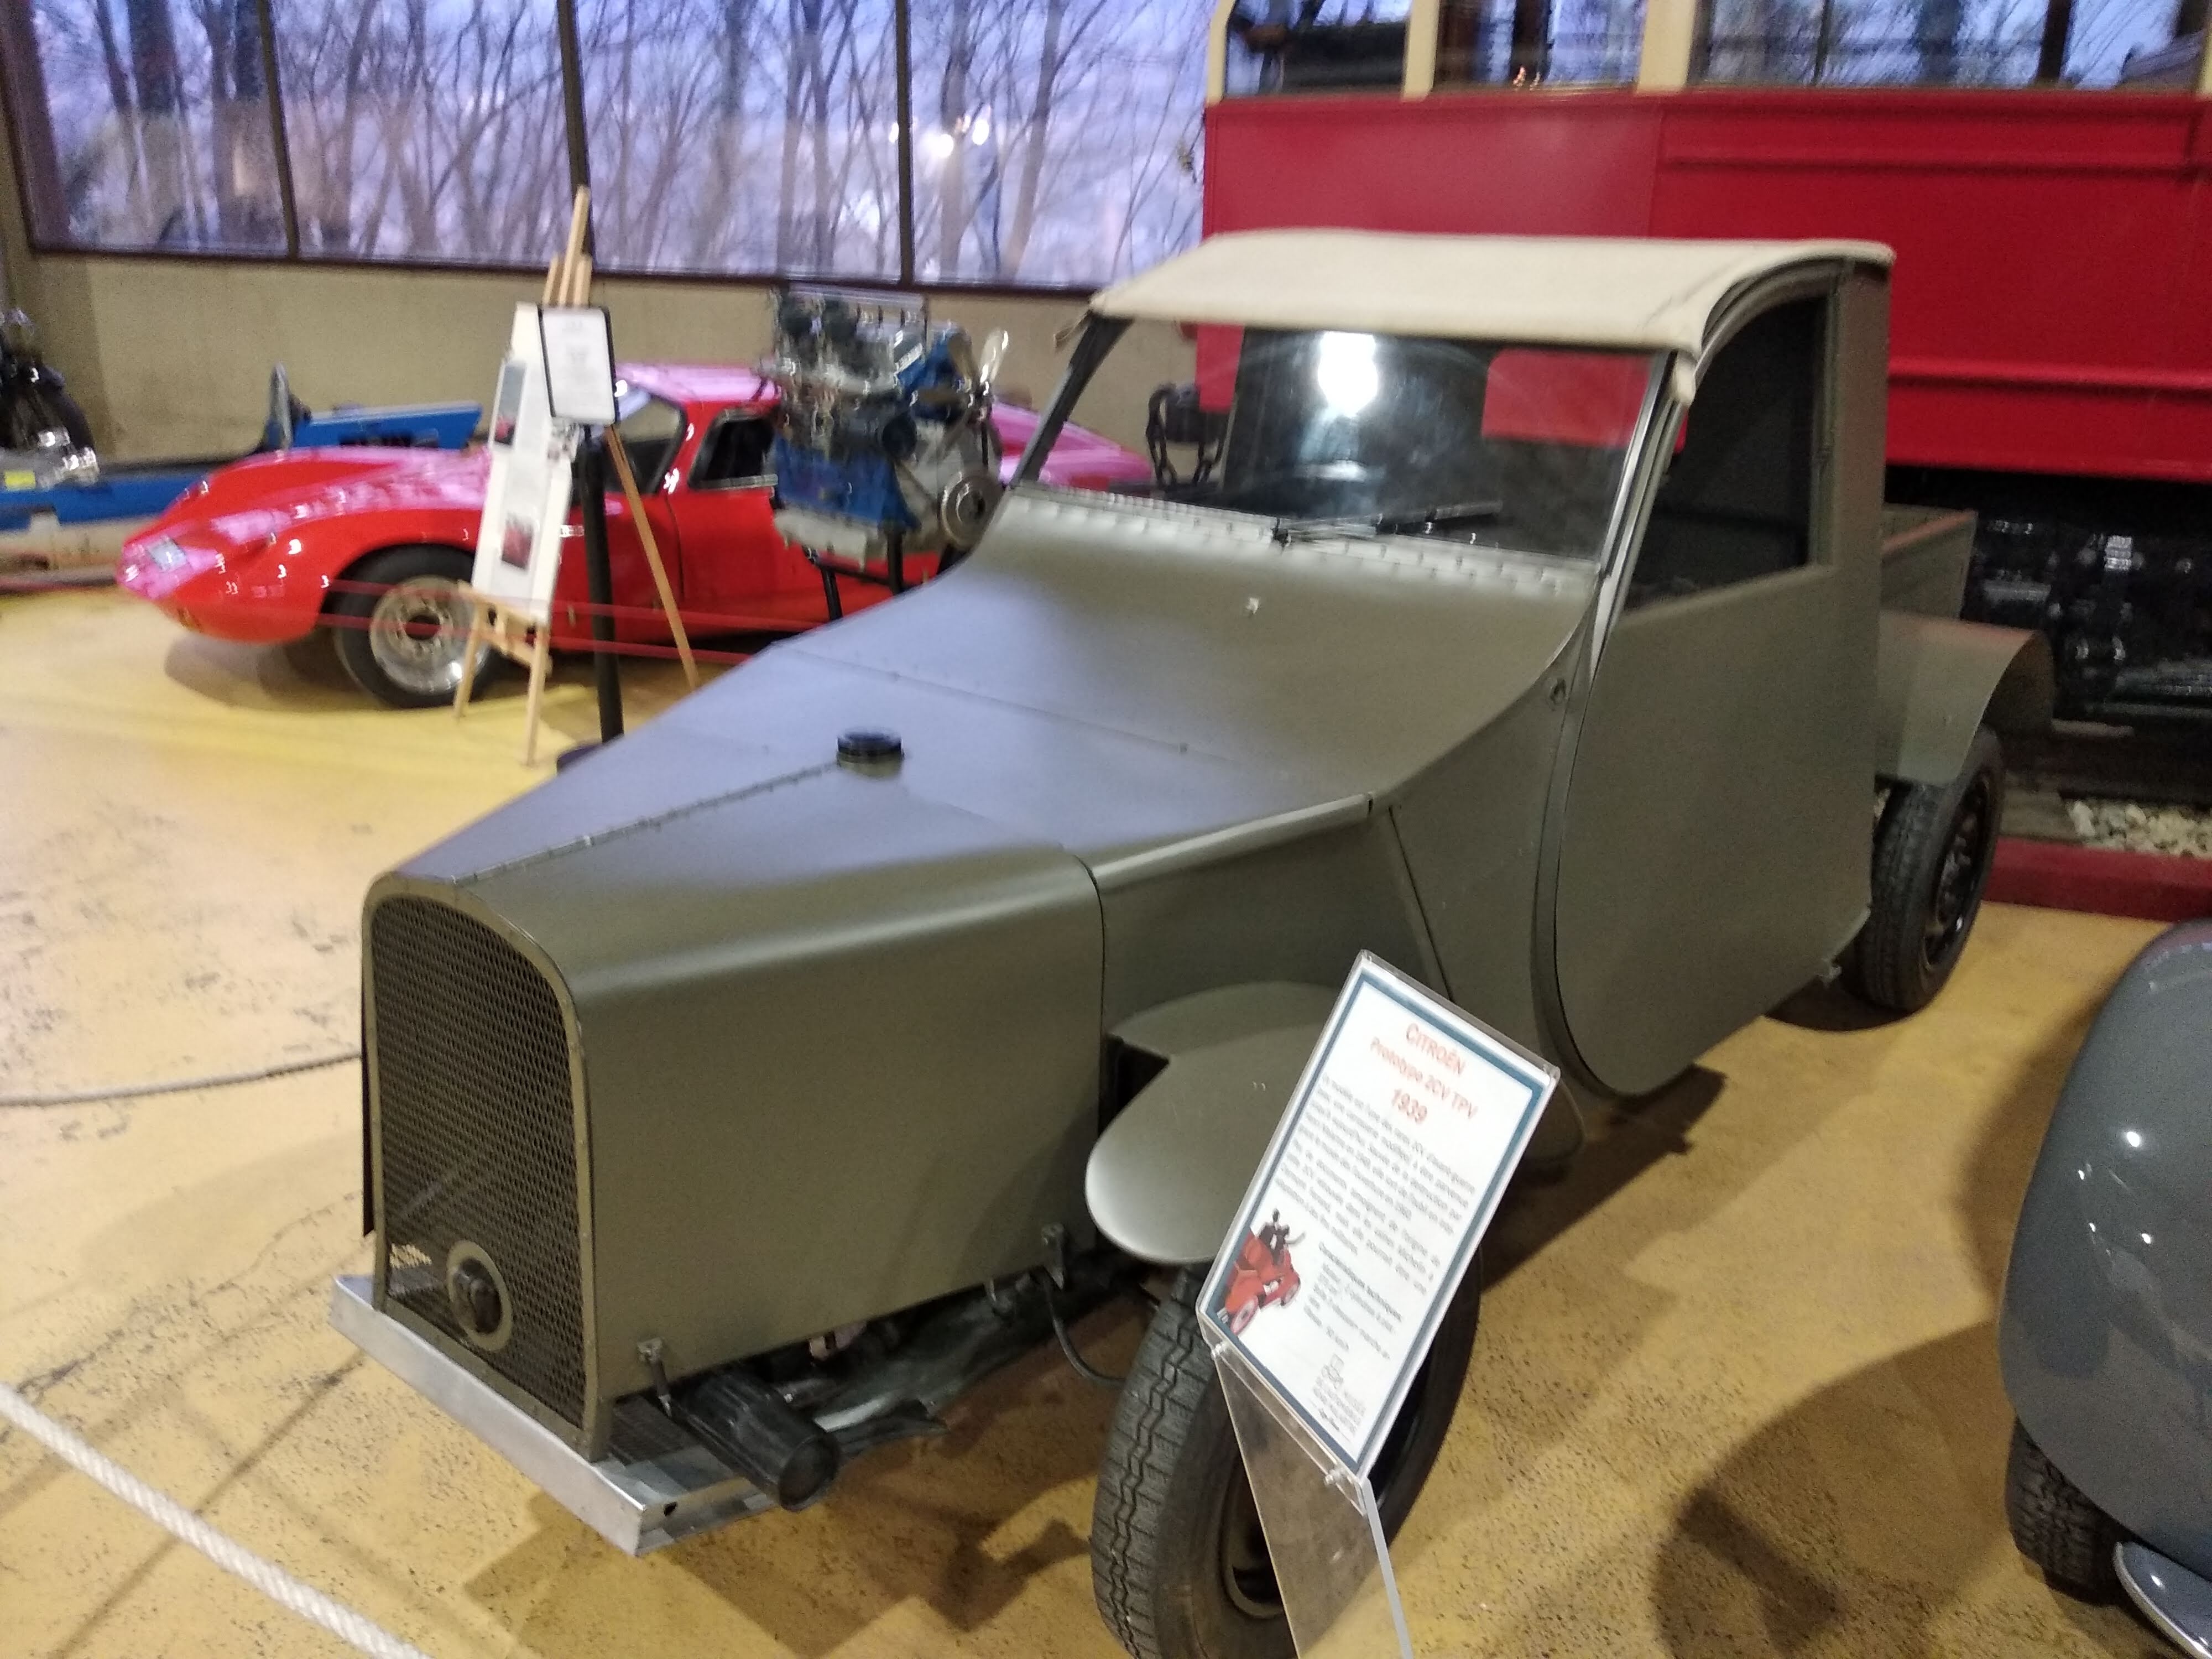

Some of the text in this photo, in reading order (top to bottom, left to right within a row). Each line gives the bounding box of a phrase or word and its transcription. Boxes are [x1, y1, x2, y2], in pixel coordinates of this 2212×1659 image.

[1369, 1036, 1479, 1119] Prototype 2CV TPV
[1390, 1088, 1428, 1124] 1939
